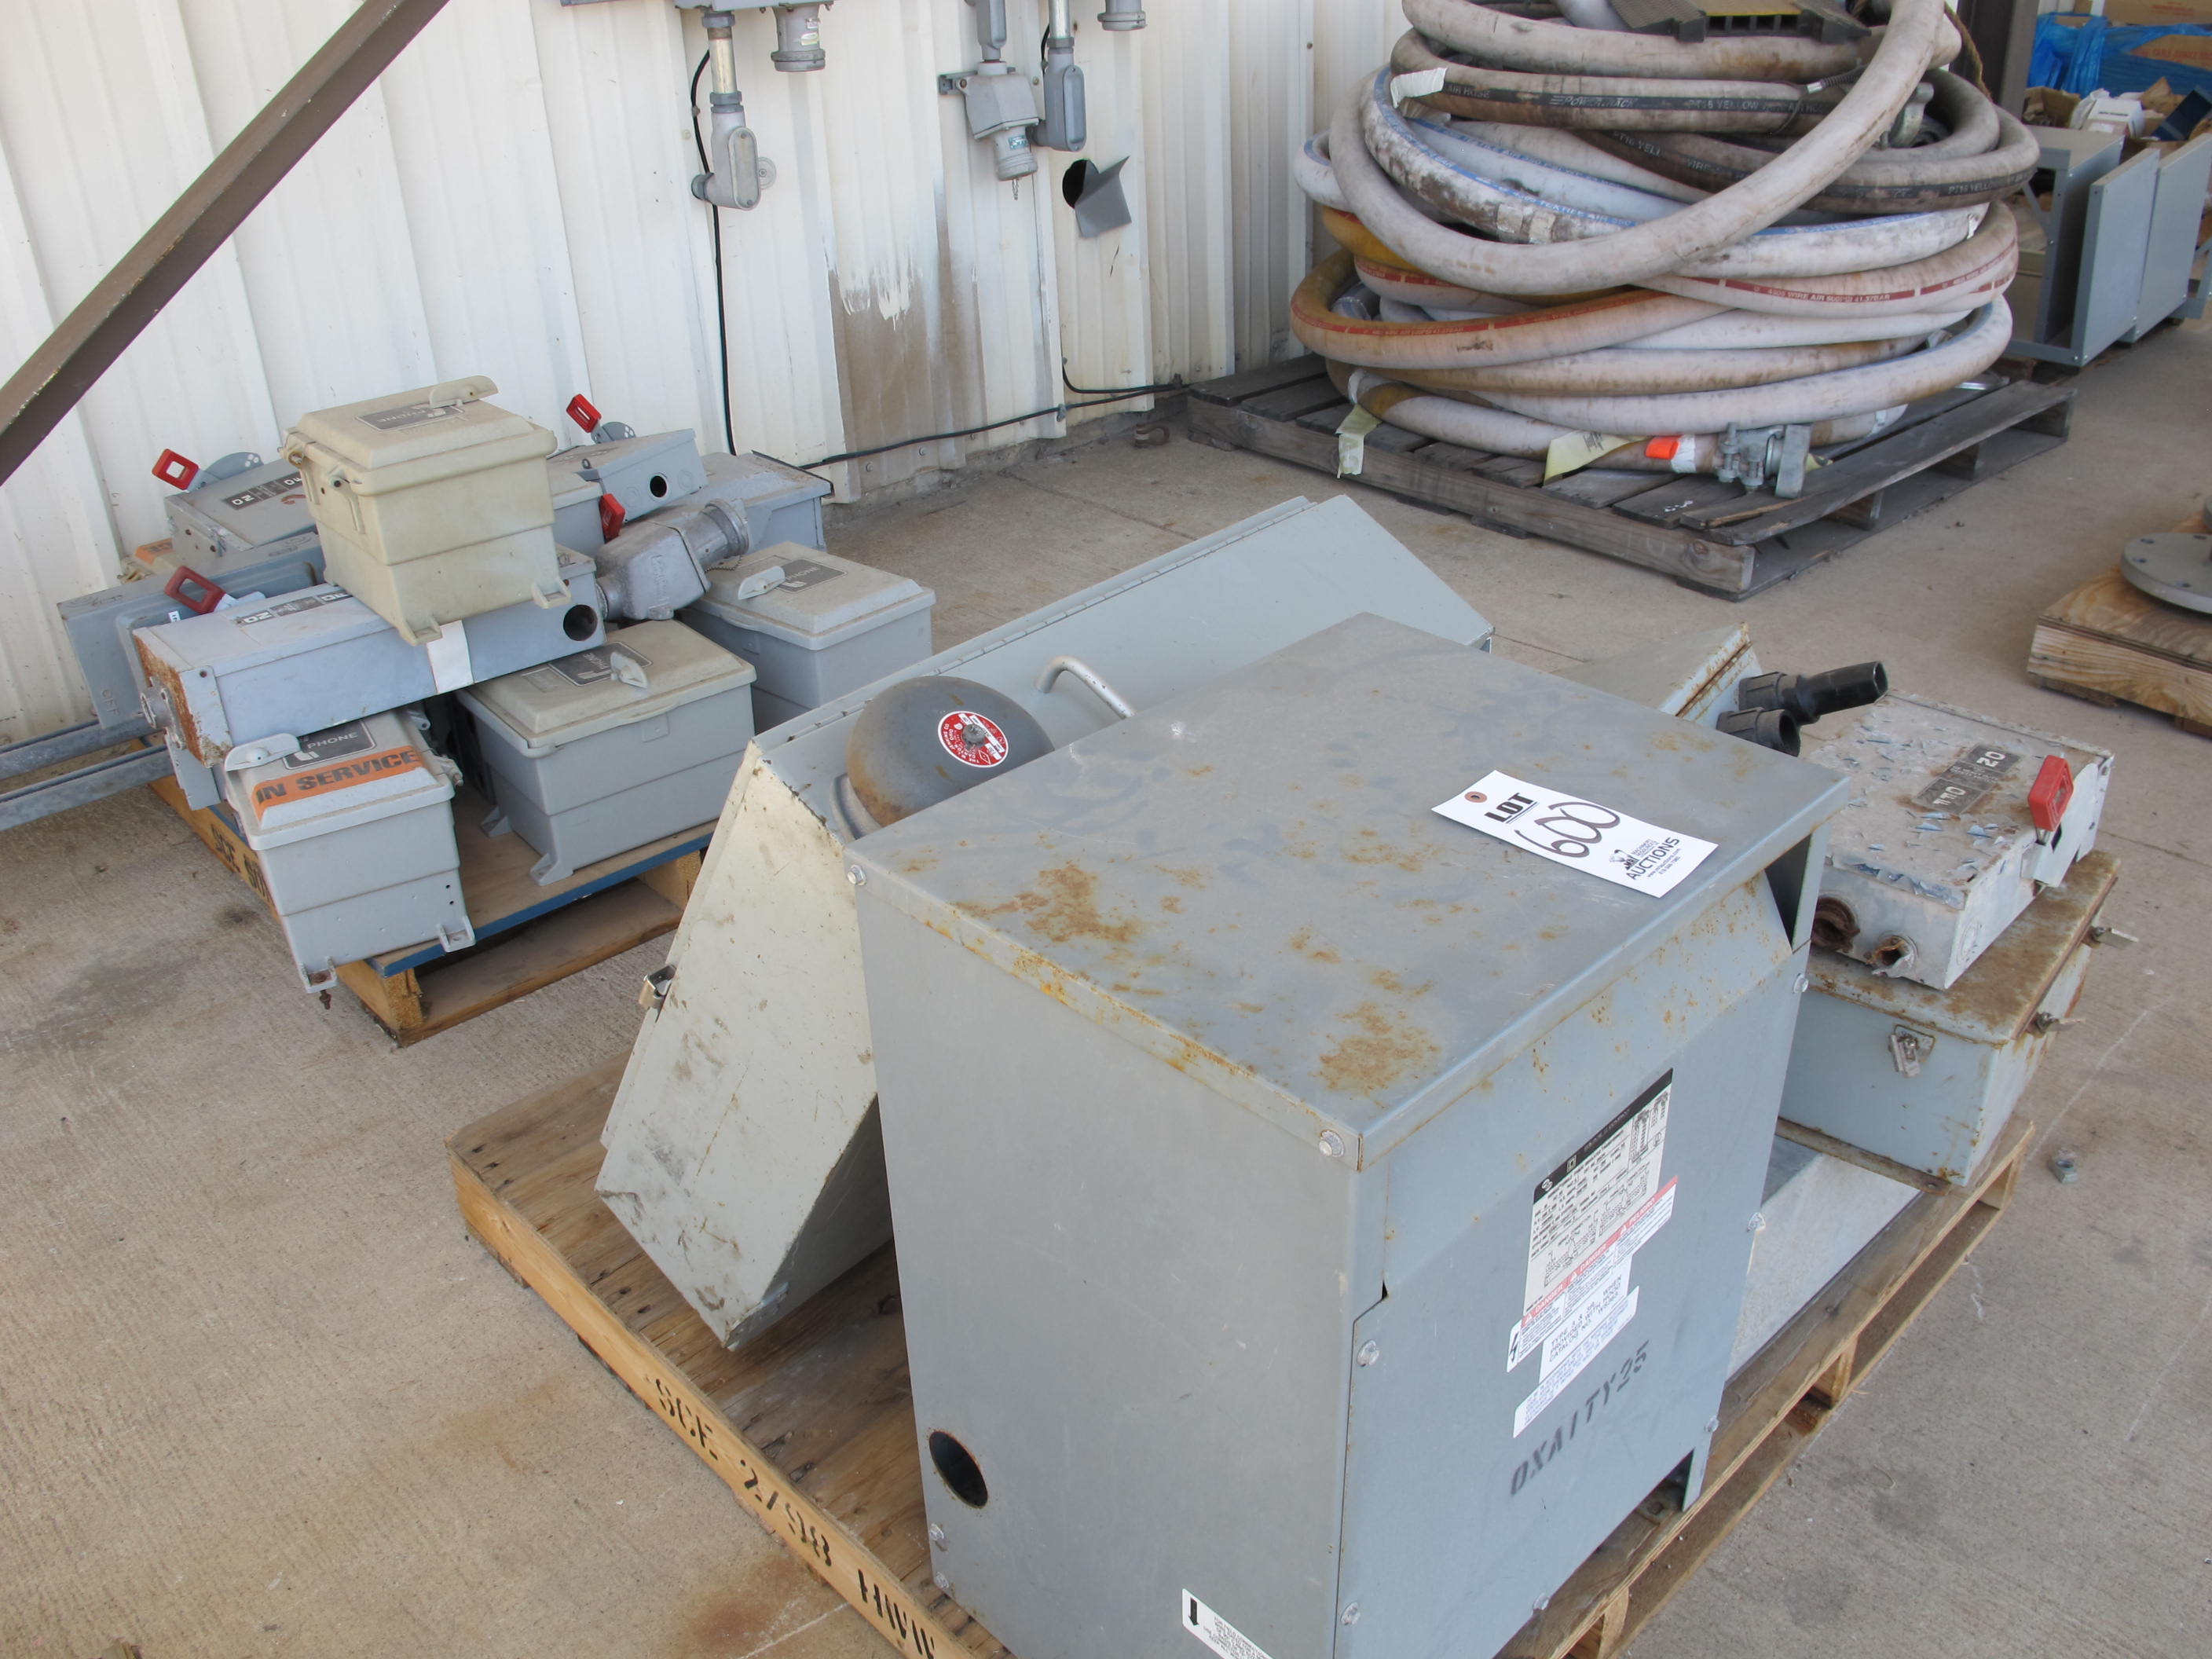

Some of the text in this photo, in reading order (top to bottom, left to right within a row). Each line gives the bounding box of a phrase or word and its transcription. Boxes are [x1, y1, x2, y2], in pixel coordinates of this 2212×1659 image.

[284, 476, 302, 485] OF
[244, 591, 349, 624] ON OF
[307, 731, 359, 749] PHONE
[1976, 750, 2005, 768] ON
[256, 750, 421, 804] IN SERVICE
[1485, 792, 1535, 823] LOT
[1933, 786, 1966, 806] OFF
[1514, 801, 1621, 859] 600
[1626, 837, 1681, 881] AUCTIONS
